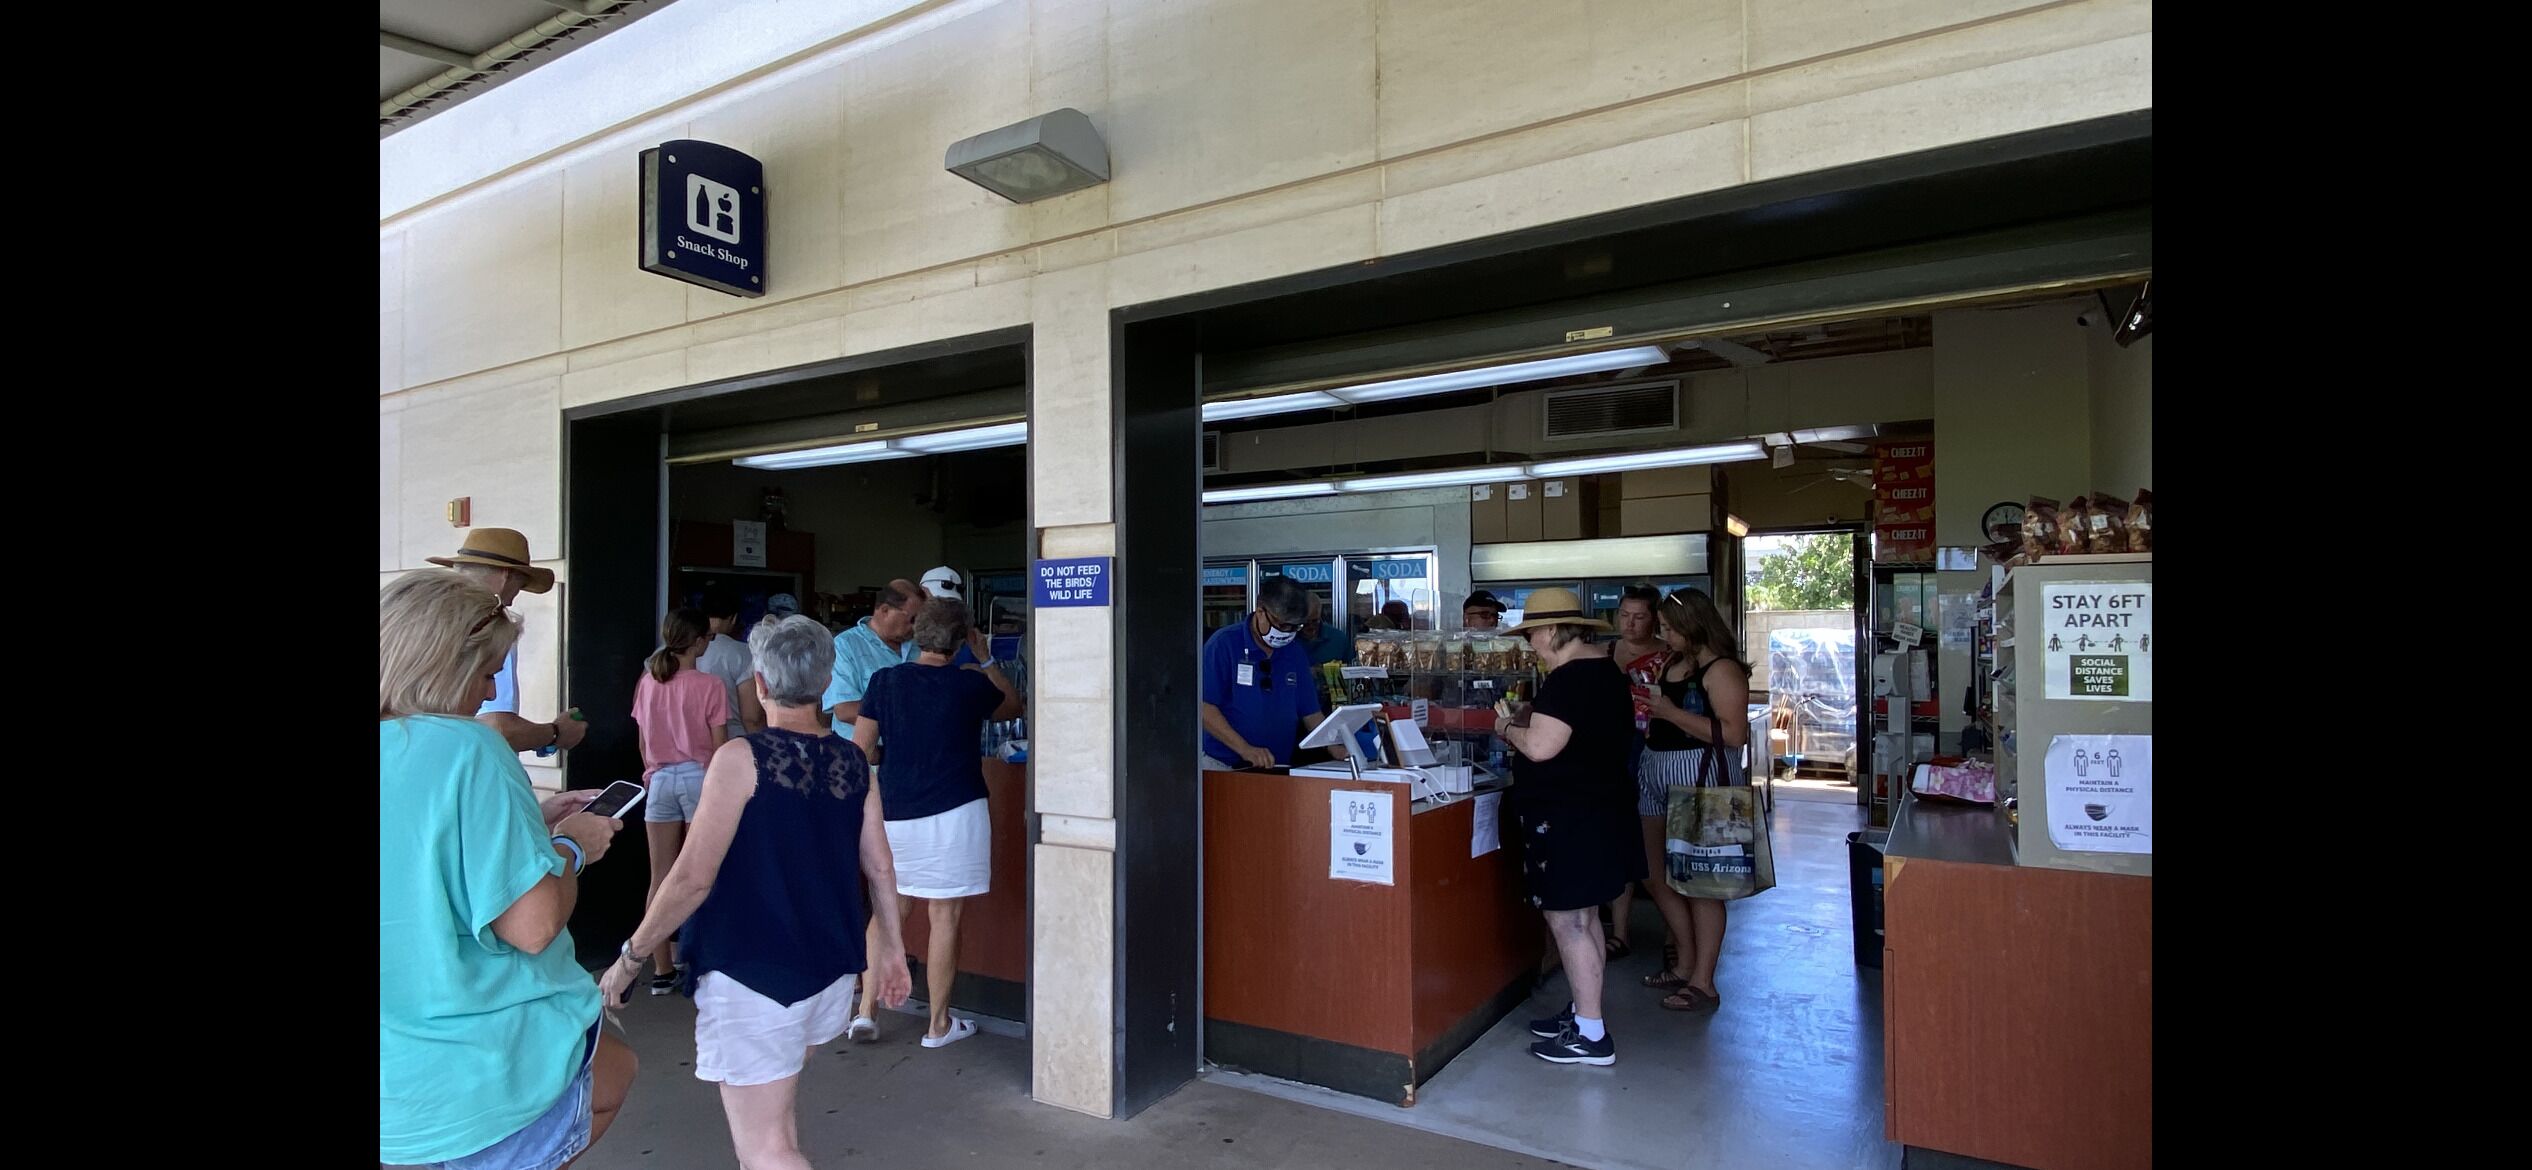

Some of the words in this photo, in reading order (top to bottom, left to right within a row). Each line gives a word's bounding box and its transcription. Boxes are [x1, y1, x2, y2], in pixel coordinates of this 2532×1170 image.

[677, 235, 716, 257] Snack
[717, 248, 749, 269] Shop
[1041, 567, 1054, 577] DO
[1057, 566, 1075, 576] NOT
[1077, 565, 1101, 575] FEED
[1288, 567, 1330, 581] SODA
[1378, 560, 1425, 577] SODA
[1045, 579, 1062, 588] THE
[1065, 576, 1097, 588] BIRDS/
[1050, 590, 1071, 600] WILD
[1074, 589, 1092, 599] LIFE
[2052, 594, 2102, 609] STAY
[2109, 594, 2145, 609] 6FT
[2064, 613, 2133, 628] APART
[2081, 658, 2115, 667] SOCIAL
[2075, 667, 2123, 675] DISTANCE
[2083, 676, 2114, 684] SAVES
[2086, 684, 2112, 693] LIVES
[2094, 752, 2101, 760] 6
[1691, 862, 1710, 872] USS
[1712, 863, 1752, 873] Arizona
